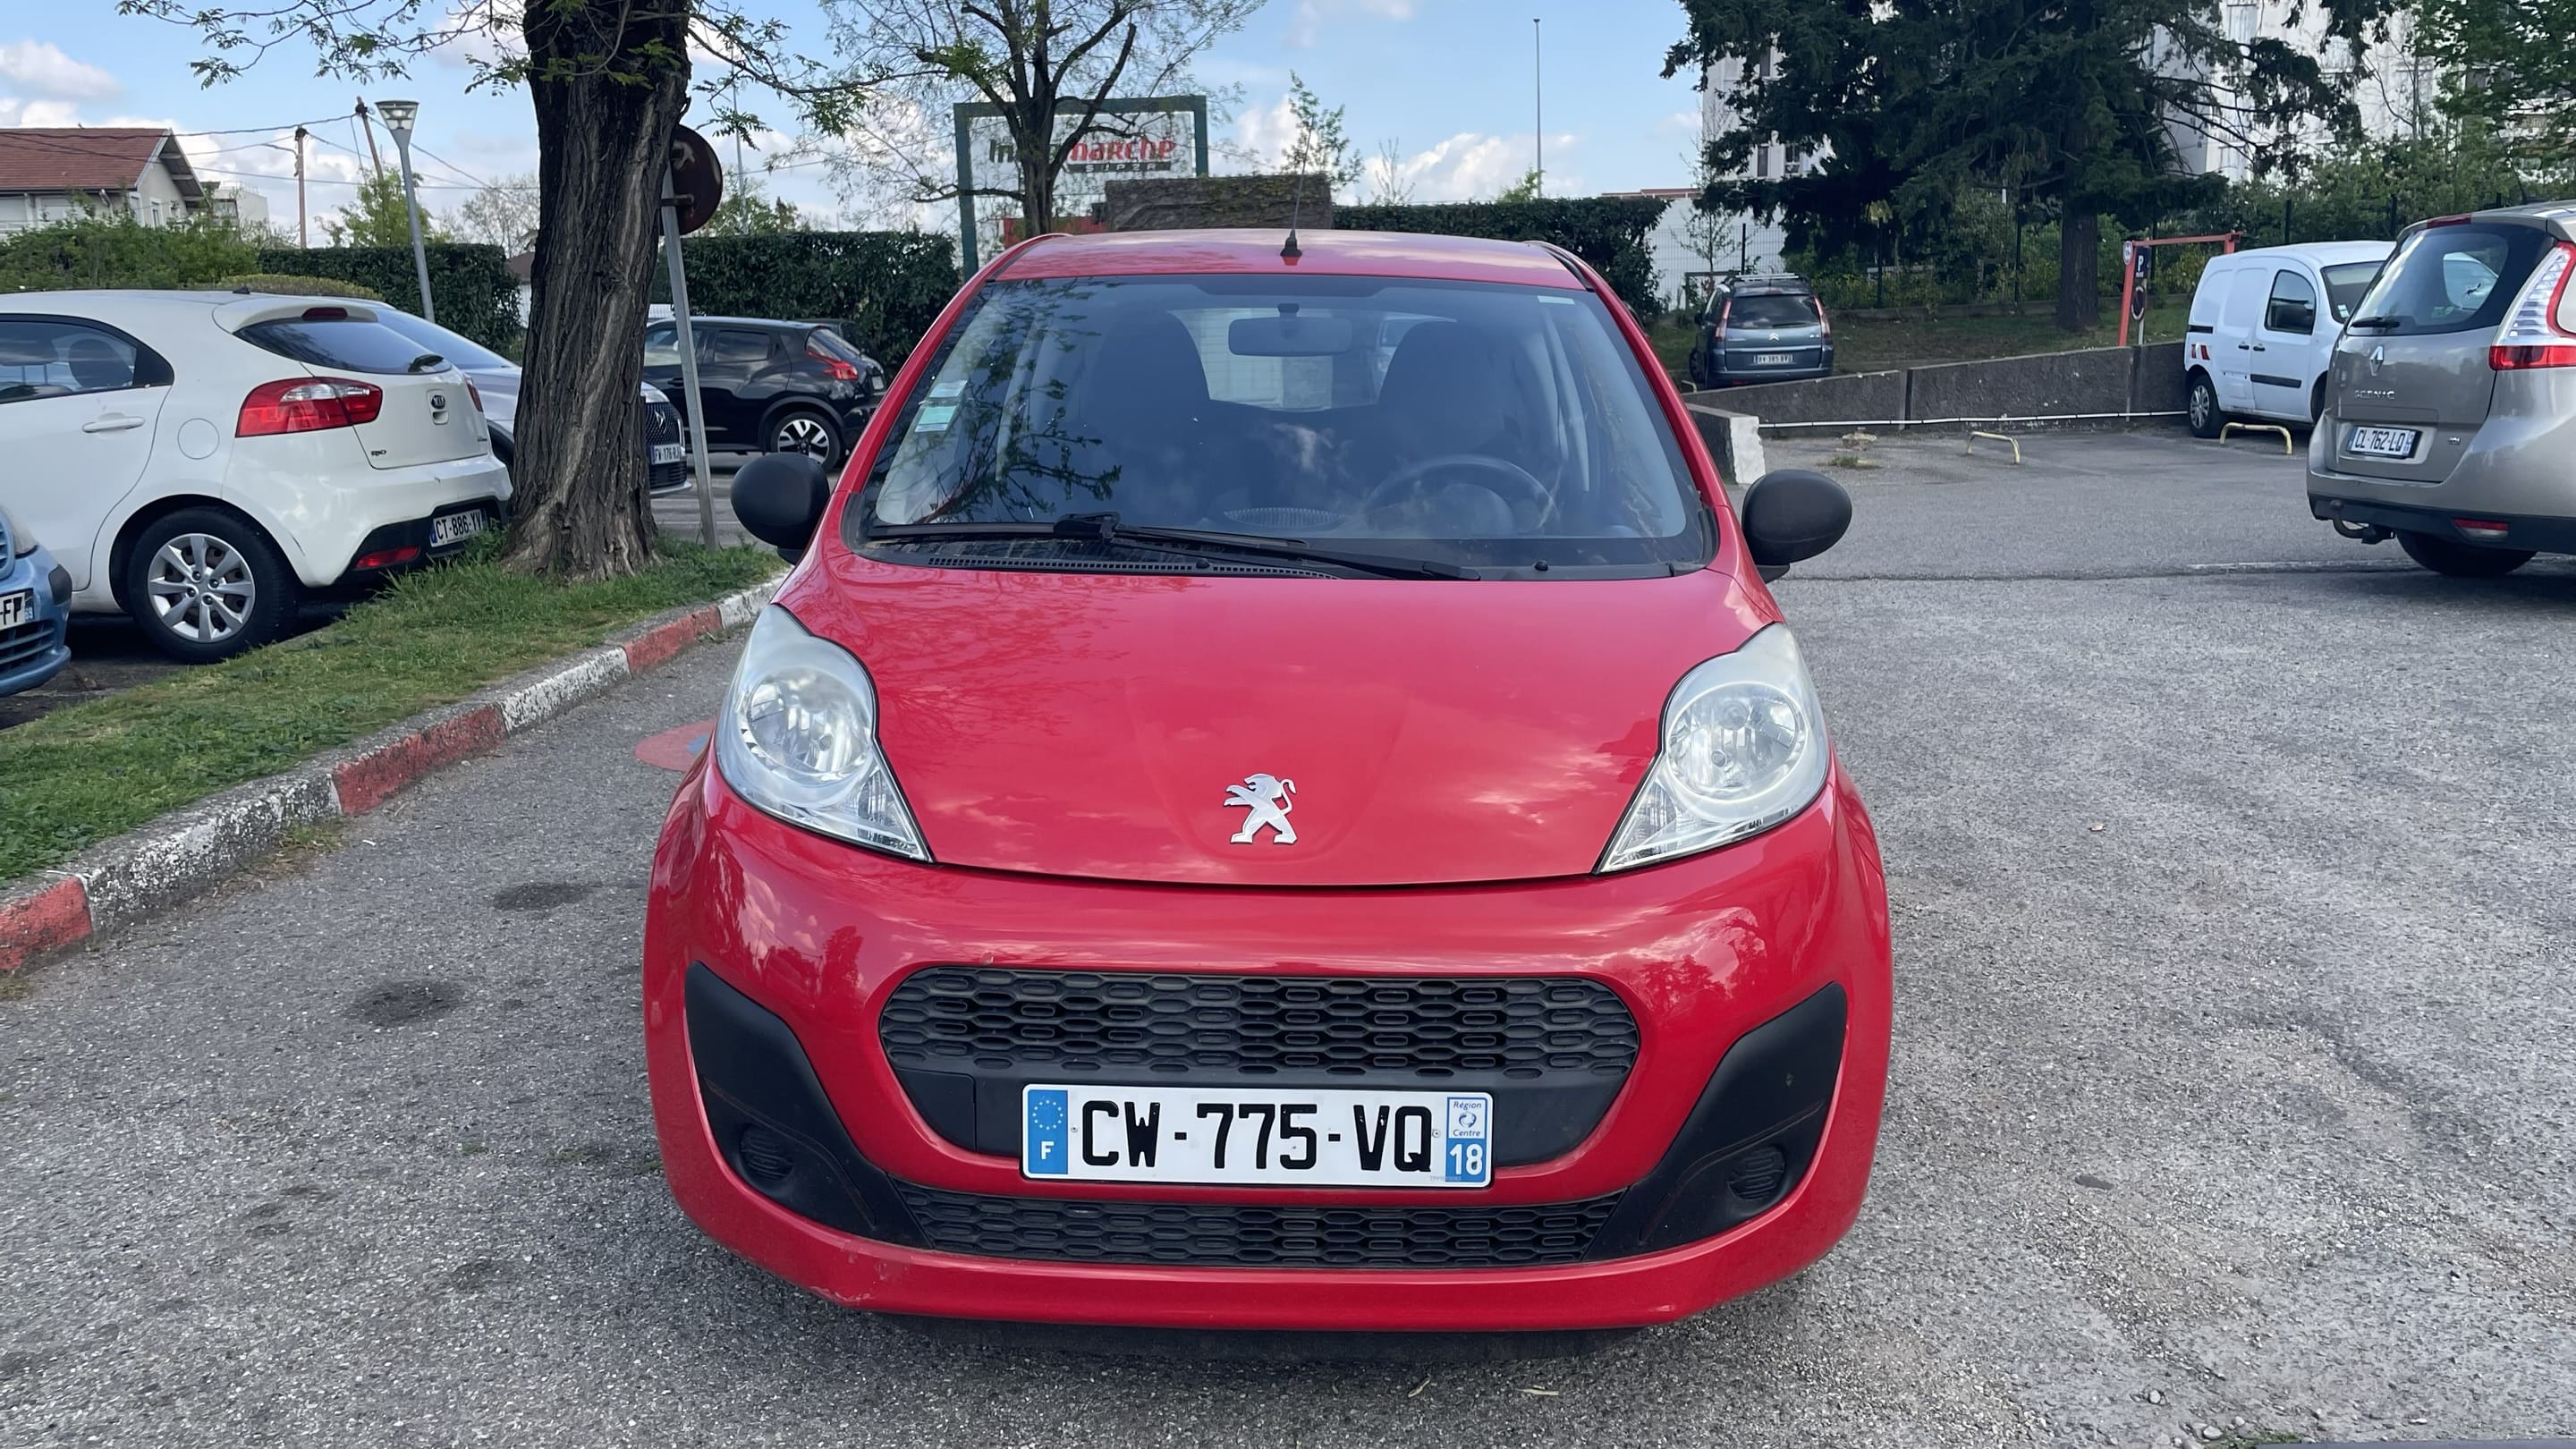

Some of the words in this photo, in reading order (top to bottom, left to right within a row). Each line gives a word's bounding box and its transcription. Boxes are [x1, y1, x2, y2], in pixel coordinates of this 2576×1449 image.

[2138, 255, 2144, 272] P
[1453, 1101, 1482, 1110] Région
[1081, 1099, 1432, 1173] CW-775-VQ
[1453, 1129, 1481, 1137] Centre
[1041, 1140, 1055, 1160] F
[1449, 1143, 1483, 1175] 18
